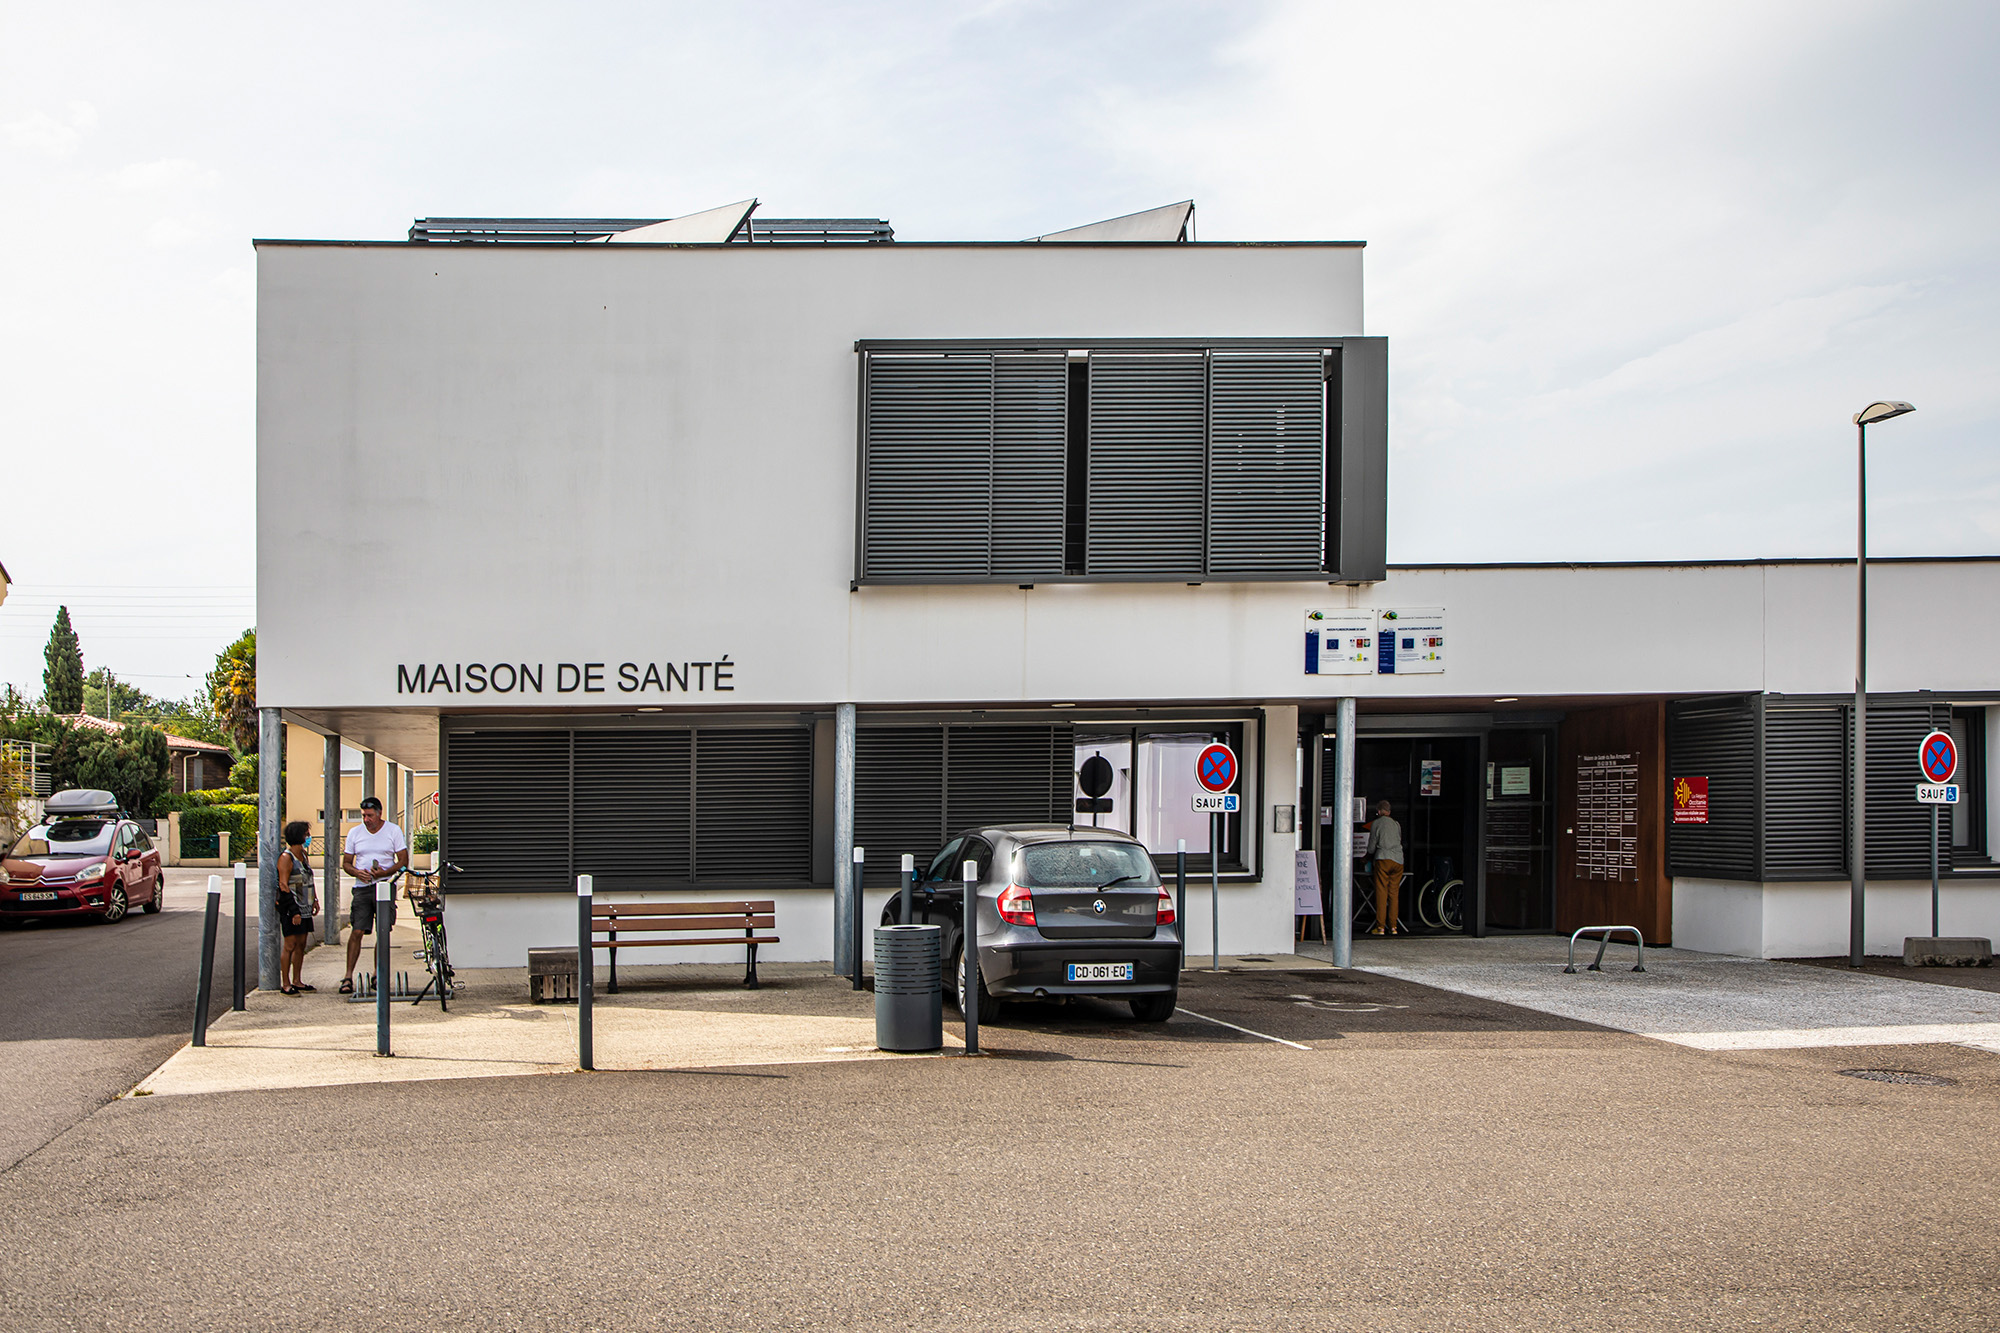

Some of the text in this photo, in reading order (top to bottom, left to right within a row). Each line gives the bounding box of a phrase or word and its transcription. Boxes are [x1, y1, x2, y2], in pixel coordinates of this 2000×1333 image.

[398, 654, 735, 693] MAISON DE SANTÉ
[1921, 788, 1944, 799] SAUF
[1196, 798, 1222, 808] SAUF
[1076, 966, 1126, 978] CD-061-EQ
